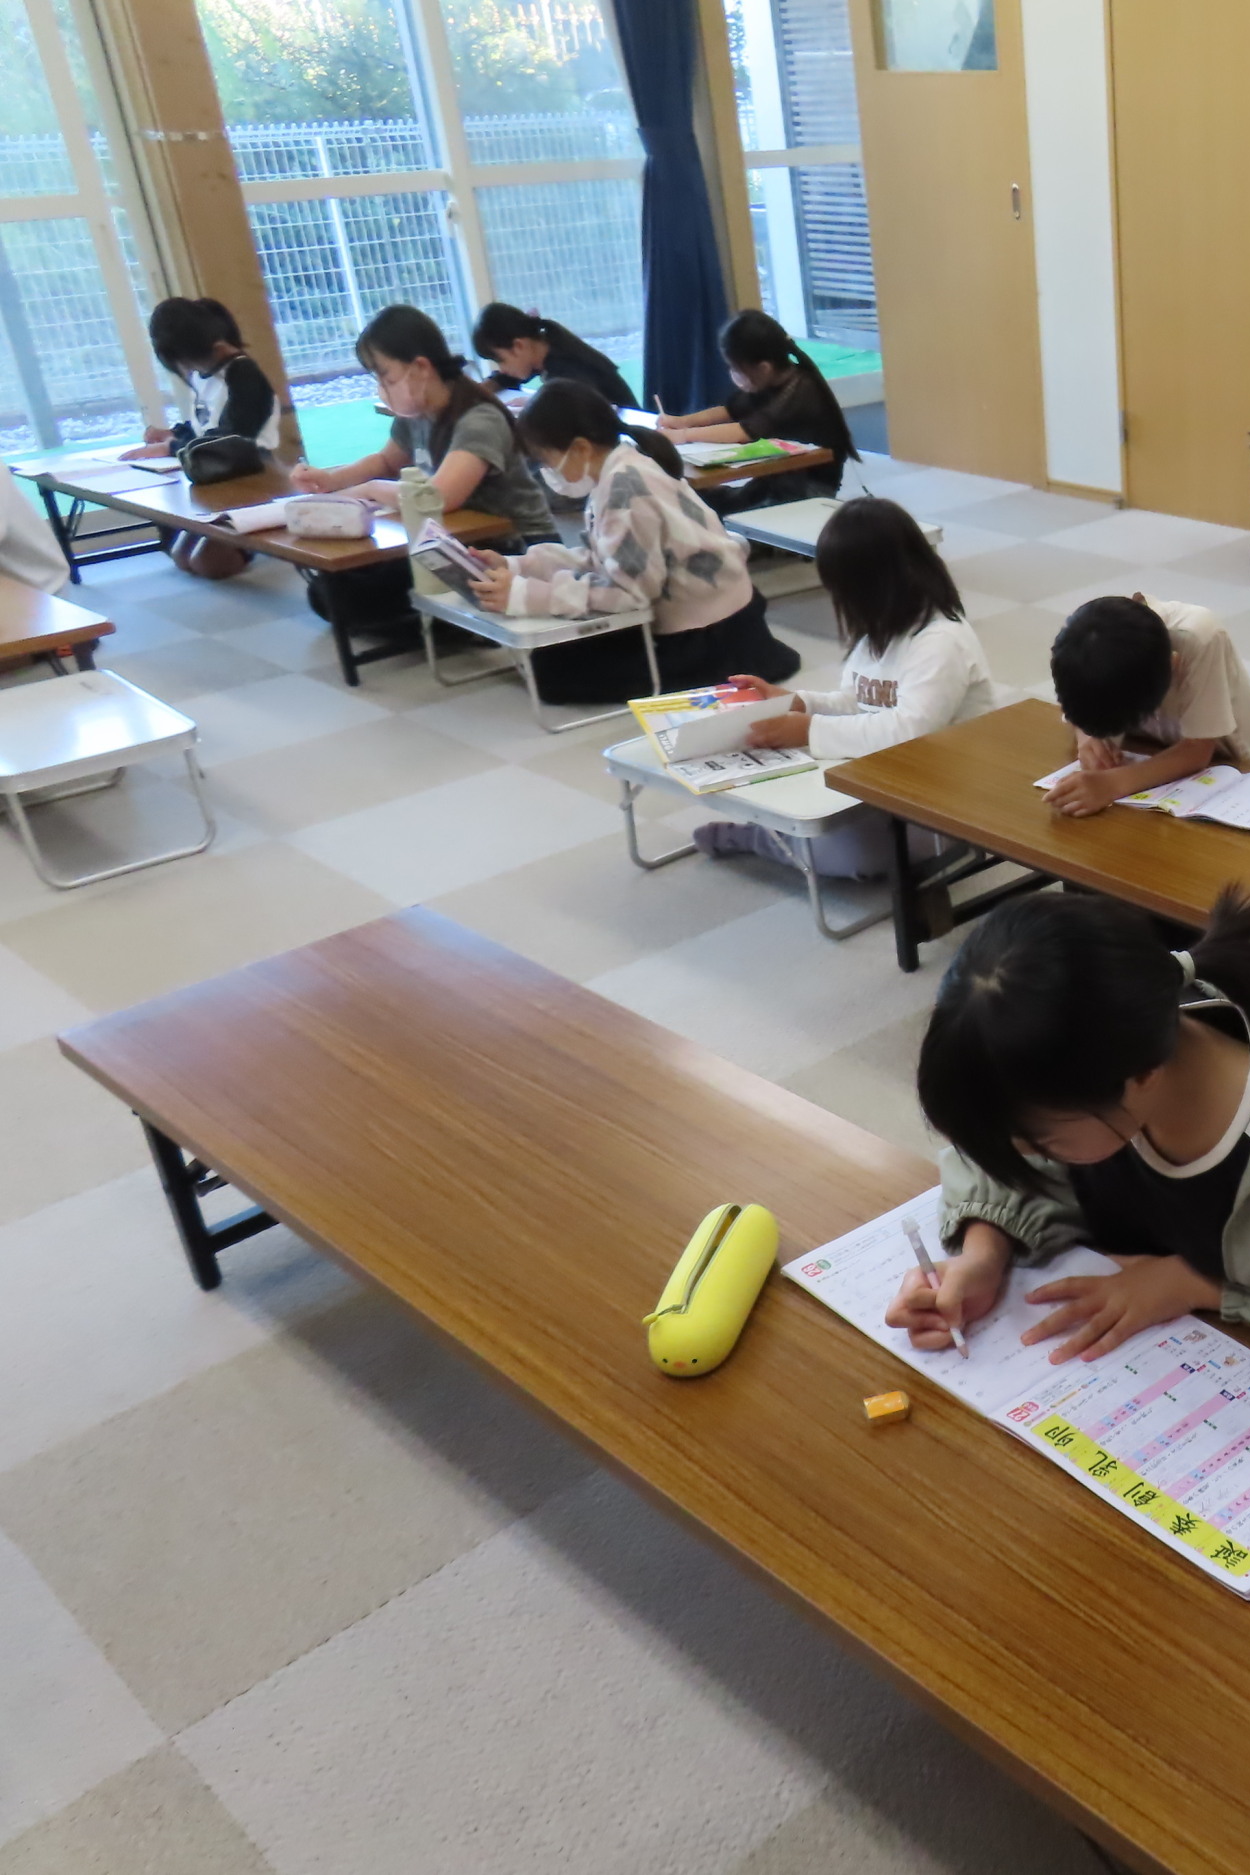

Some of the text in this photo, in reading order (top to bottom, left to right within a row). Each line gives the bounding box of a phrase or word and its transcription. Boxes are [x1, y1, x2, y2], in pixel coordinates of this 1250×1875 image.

[1006, 1405, 1031, 1423] 27
[1044, 1424, 1076, 1448] 卵
[1088, 1450, 1118, 1479] 乳
[1123, 1480, 1161, 1508] 創
[1169, 1511, 1201, 1538] 奏
[1209, 1539, 1249, 1569] 誕
